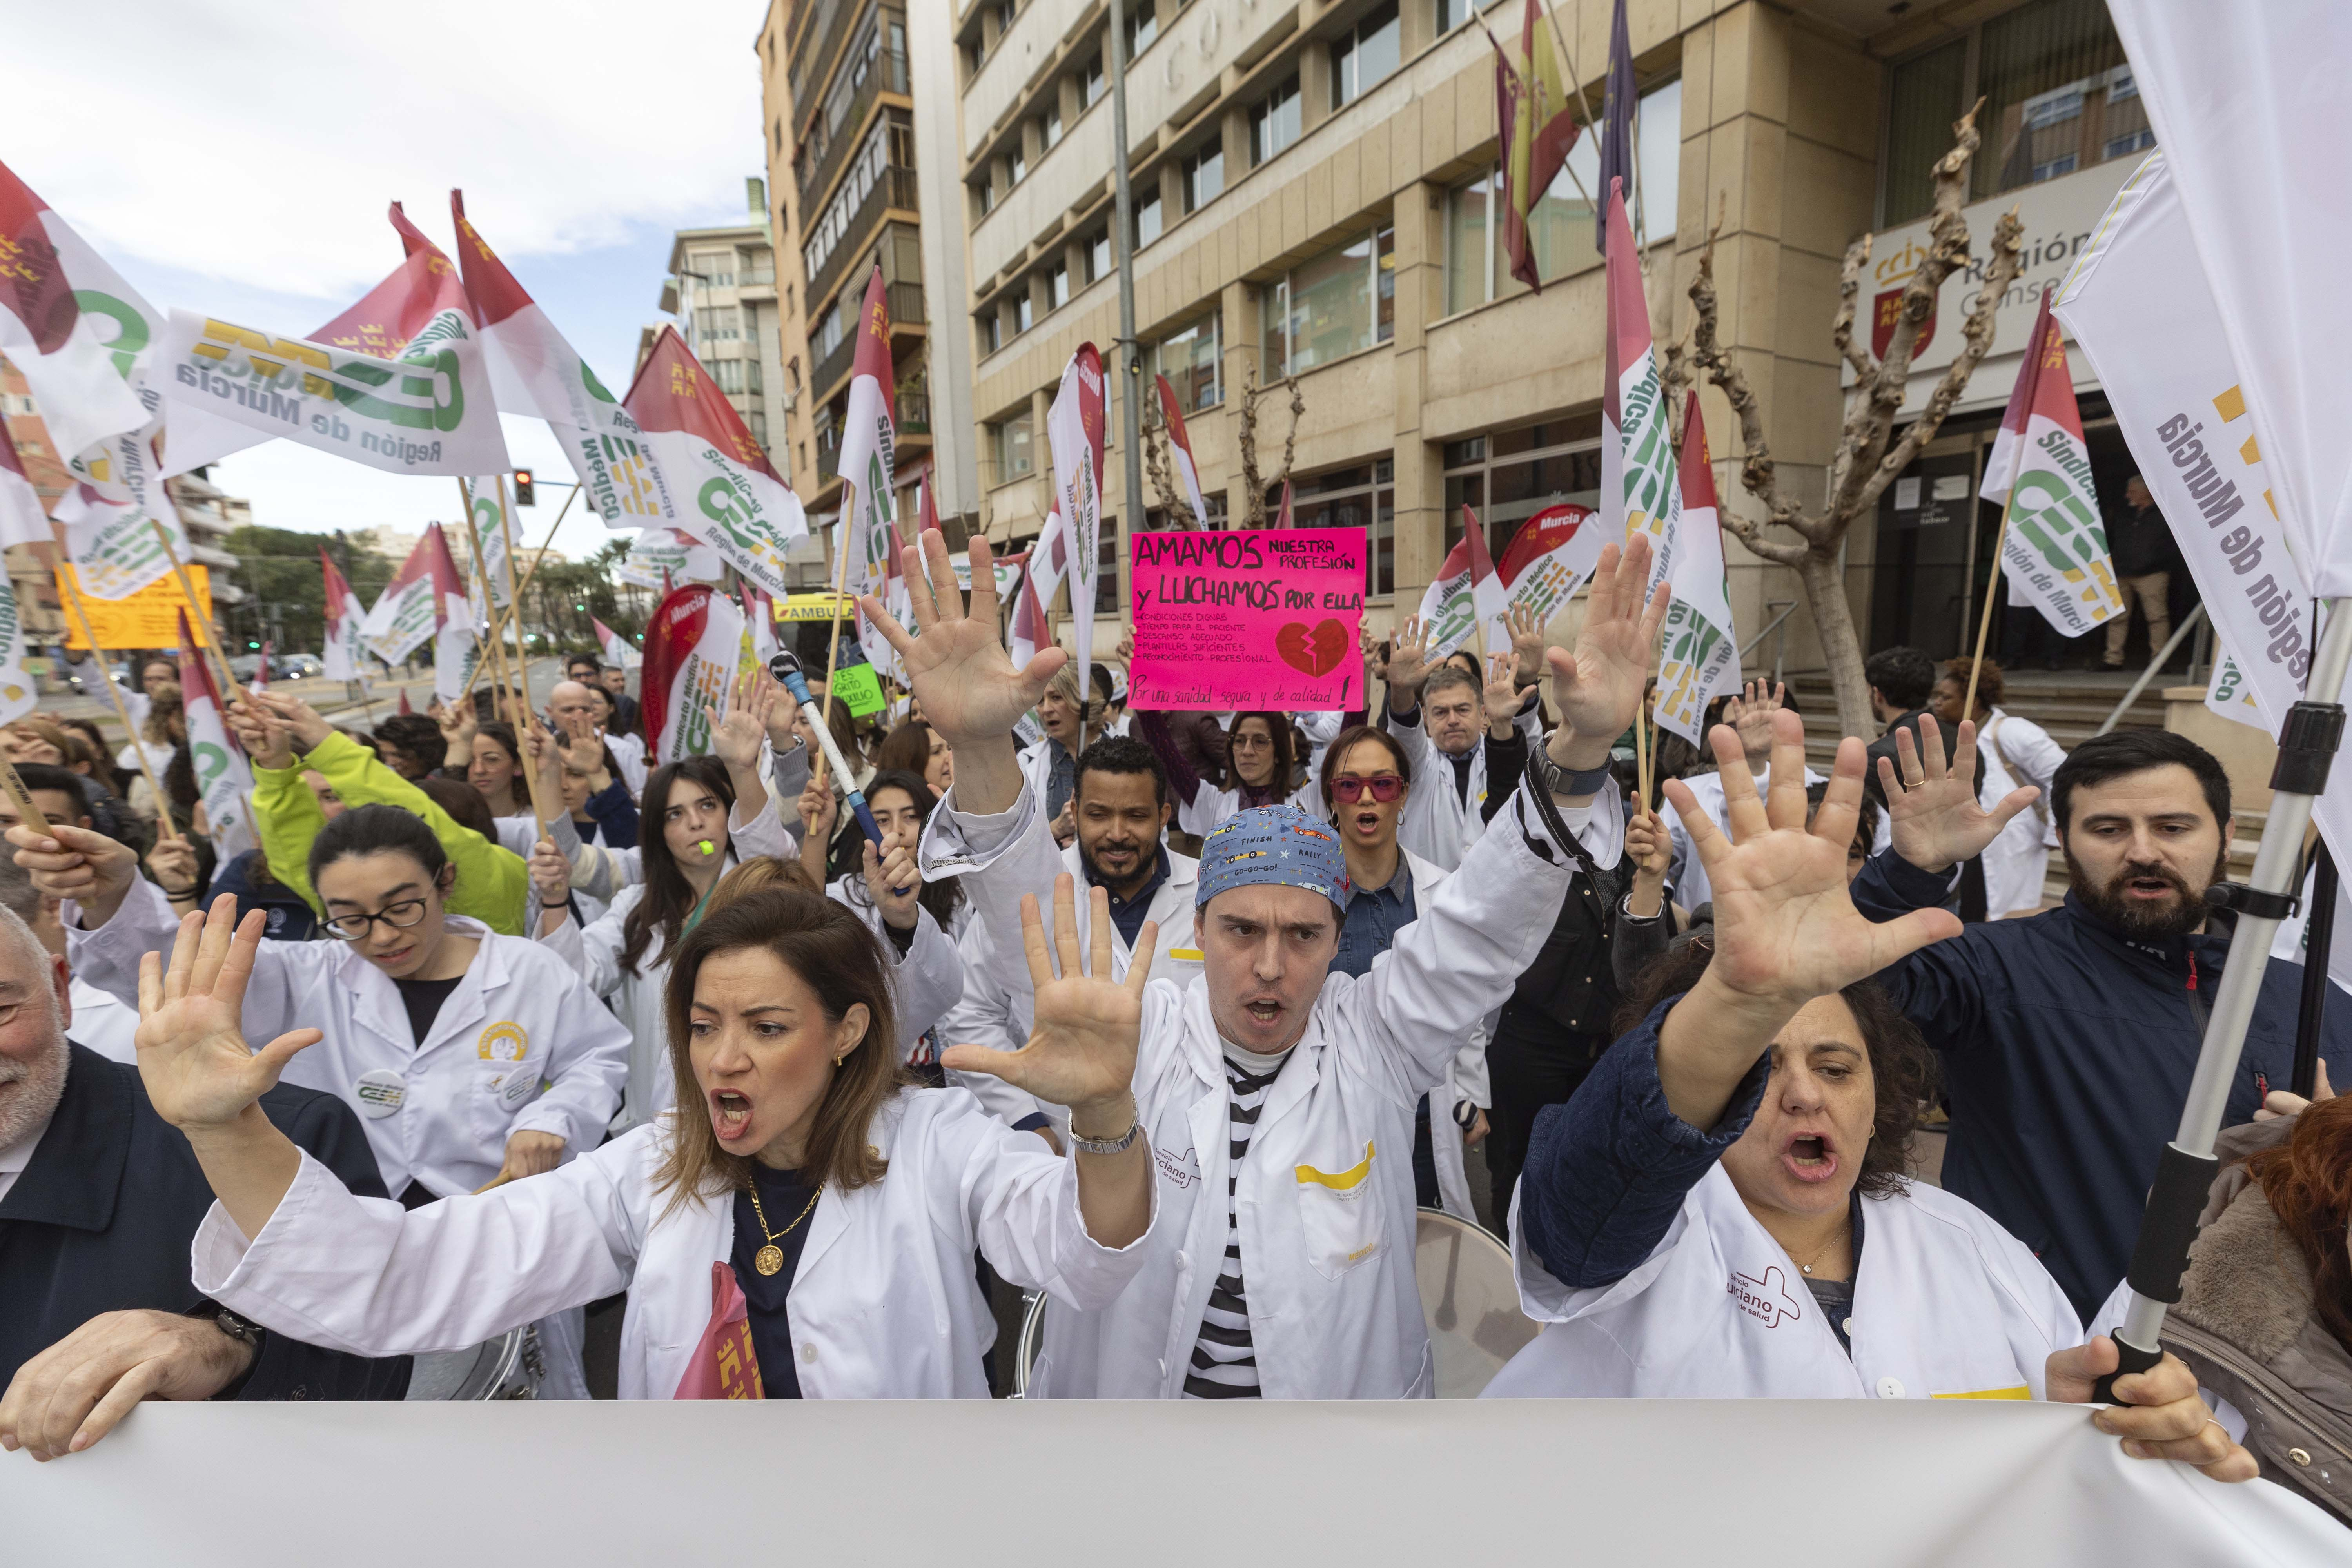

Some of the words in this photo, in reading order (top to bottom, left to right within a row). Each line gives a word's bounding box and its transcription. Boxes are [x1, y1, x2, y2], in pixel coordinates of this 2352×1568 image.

[1540, 512, 1580, 531] Murcia
[705, 526, 737, 559] Región
[736, 554, 750, 568] de
[750, 561, 786, 593] Murcia
[1135, 535, 1263, 569] AMAMOS
[1268, 540, 1335, 553] NUESTRA
[1279, 553, 1356, 570] PROFESIÓN
[1526, 554, 1554, 586] Médico
[1555, 595, 1564, 605] de
[1561, 573, 1581, 597] Murcia
[2030, 572, 2054, 592] de
[1158, 574, 1282, 611] LUCHAMOS
[1285, 589, 1316, 610] POR
[1323, 592, 1362, 611] ELLA
[670, 594, 707, 624] Murcia
[840, 670, 855, 681] ES
[834, 680, 862, 694] GRITO
[1130, 674, 1150, 702] Por
[1151, 689, 1169, 704] una
[1174, 685, 1212, 704] sanidad
[1220, 689, 1252, 709] segura
[1260, 690, 1267, 710] y
[1273, 685, 1285, 701] de
[1290, 686, 1332, 702] calidad
[671, 701, 690, 760] Sindicato
[683, 653, 699, 701] Médico
[1241, 835, 1272, 846] FINISH
[1299, 849, 1321, 859] RALLY
[1234, 864, 1278, 876] GO-GO-GO!
[1155, 1156, 1186, 1179] rciano
[1169, 1176, 1183, 1185] salud
[1348, 1243, 1373, 1261] MÉDICO
[1727, 1283, 1772, 1312] urciano
[1748, 1308, 1770, 1322] salud
